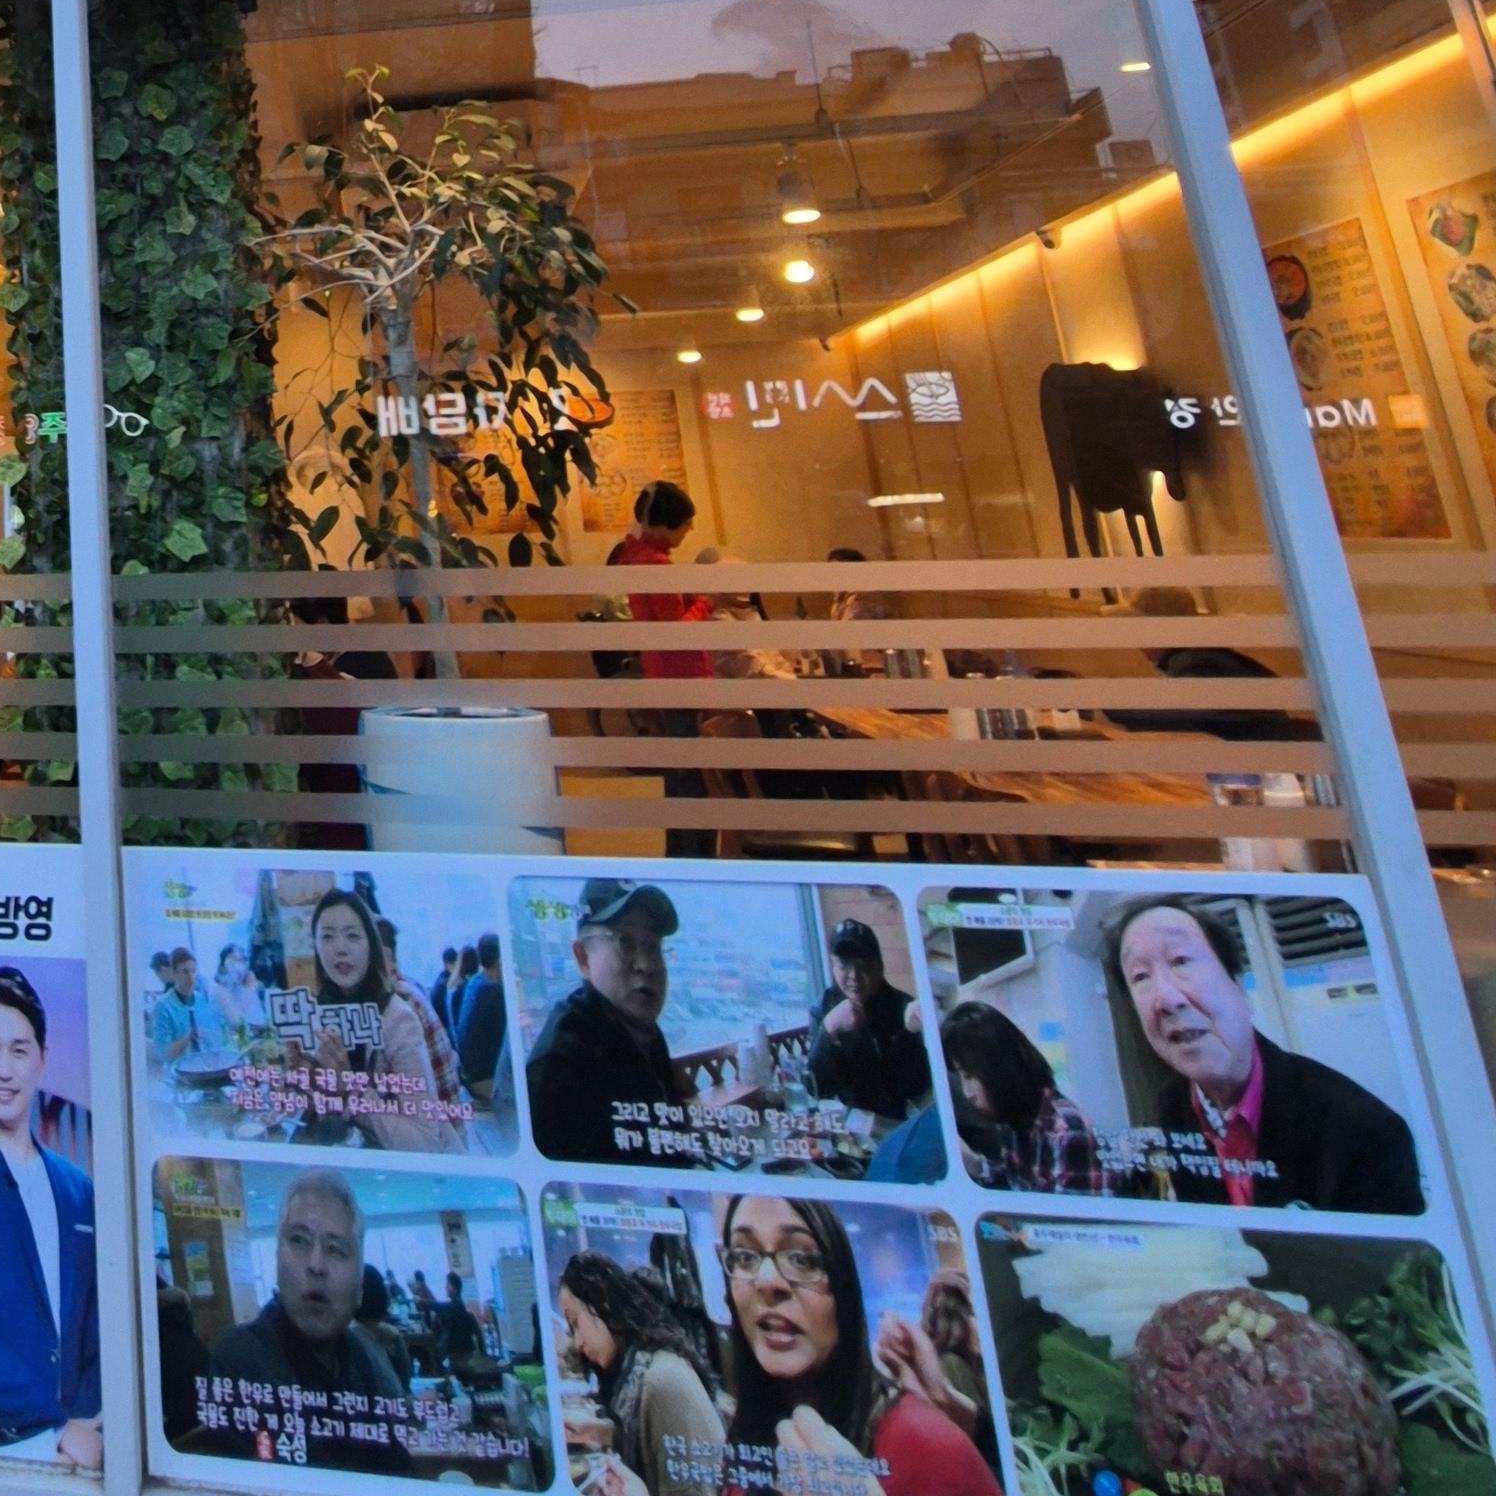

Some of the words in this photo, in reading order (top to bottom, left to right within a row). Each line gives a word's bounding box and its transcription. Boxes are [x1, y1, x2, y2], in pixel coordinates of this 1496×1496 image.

[270, 989, 316, 1052] 딱
[228, 1066, 283, 1087] 예전에는
[314, 1069, 338, 1091] 국물
[341, 1071, 370, 1092] 맛만
[229, 1088, 265, 1110] 지금은
[269, 1090, 309, 1112] 양념이
[312, 1092, 344, 1115] 함께
[347, 1096, 399, 1116] 우러나서
[403, 1101, 417, 1116] 더
[421, 1100, 473, 1121] 맛있어요
[611, 1100, 651, 1122] 그리고
[653, 1102, 685, 1126] 맛이
[687, 1104, 729, 1130] 있으면
[647, 1128, 703, 1155] 불편해도
[706, 1131, 766, 1157] 찾아오게
[194, 1376, 208, 1401] 질
[212, 1377, 235, 1403] 좋은
[238, 1379, 274, 1406] 한우로
[278, 1385, 329, 1413] 만들어서
[332, 1390, 369, 1415] 그런지
[374, 1395, 410, 1417] 고기도
[412, 1398, 463, 1428] 부드럽고
[196, 1402, 229, 1430] 국물도
[232, 1405, 260, 1432] 진한
[310, 1416, 346, 1438] 소고기
[349, 1420, 389, 1445] 제대로
[393, 1426, 419, 1448] 먹고
